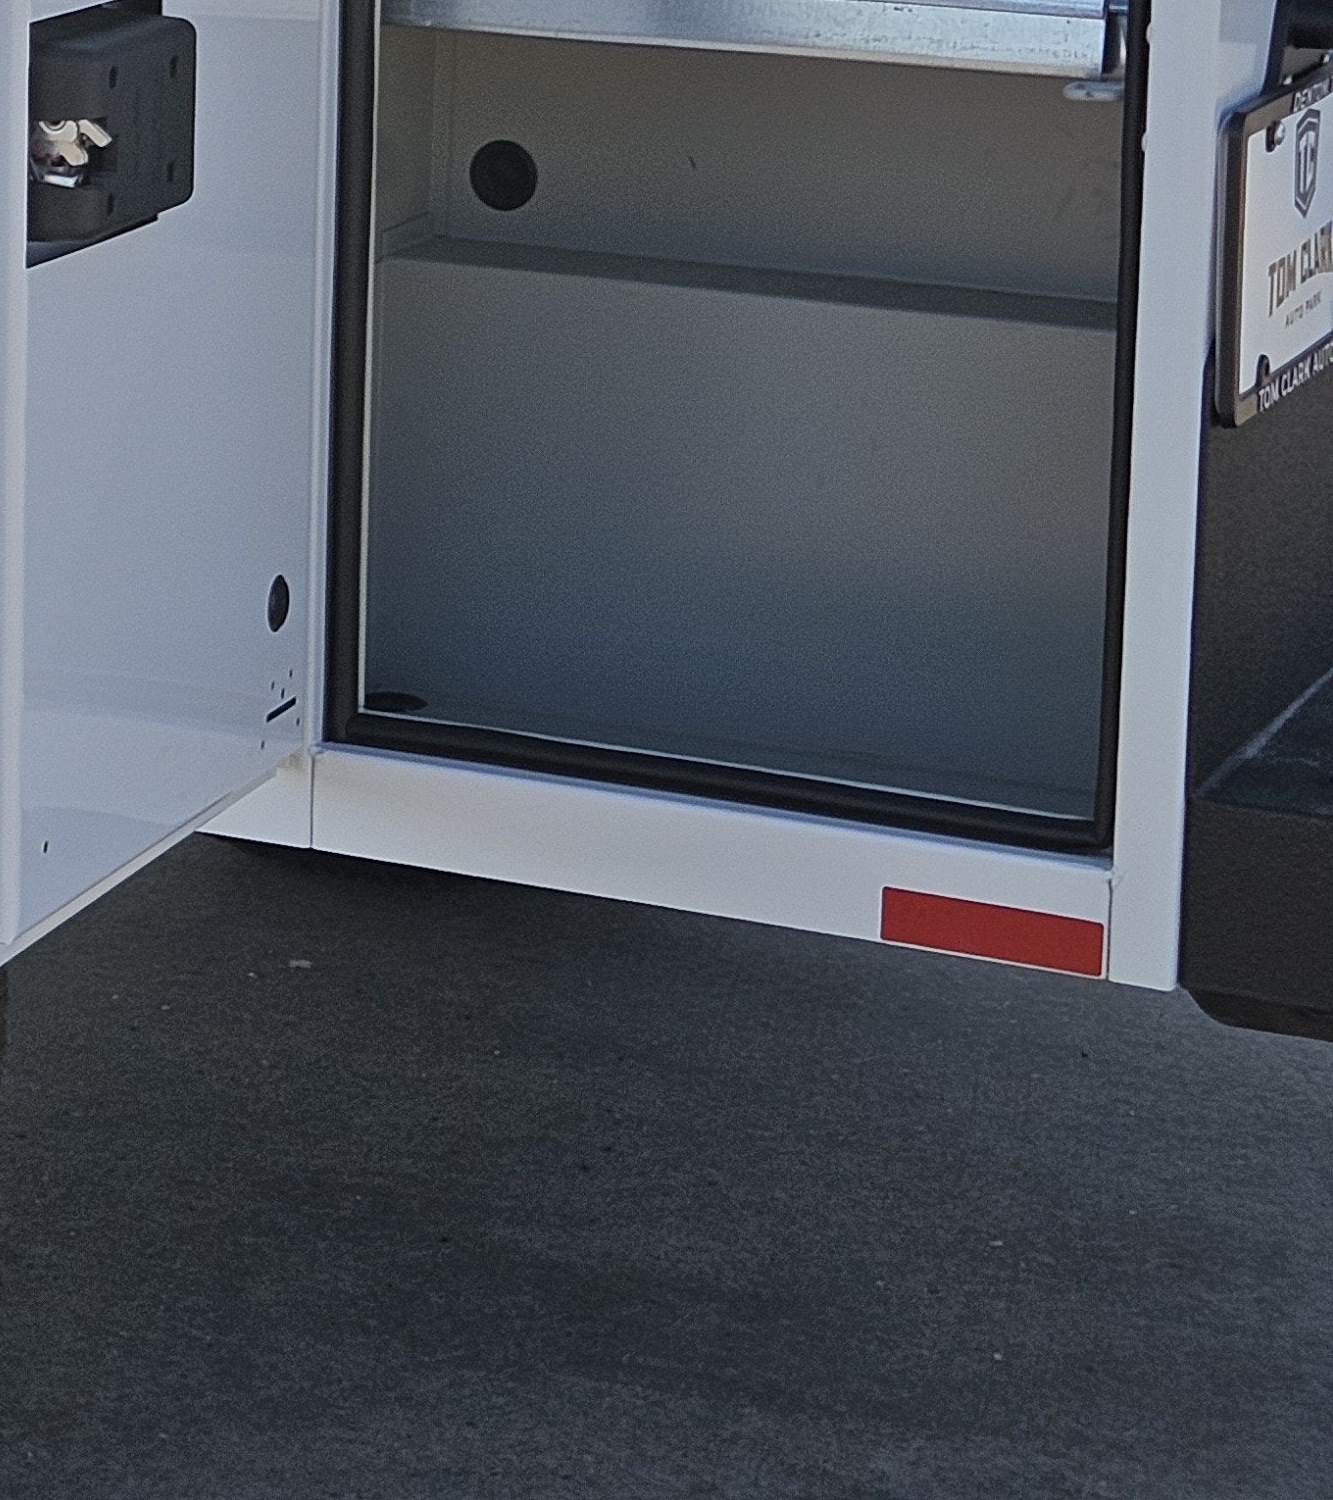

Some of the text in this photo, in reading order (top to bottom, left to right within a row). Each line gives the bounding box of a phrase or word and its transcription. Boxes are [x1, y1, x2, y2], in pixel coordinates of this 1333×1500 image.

[1268, 249, 1297, 318] TOM
[1258, 378, 1279, 412] TOM
[1280, 358, 1311, 397] CLARK
